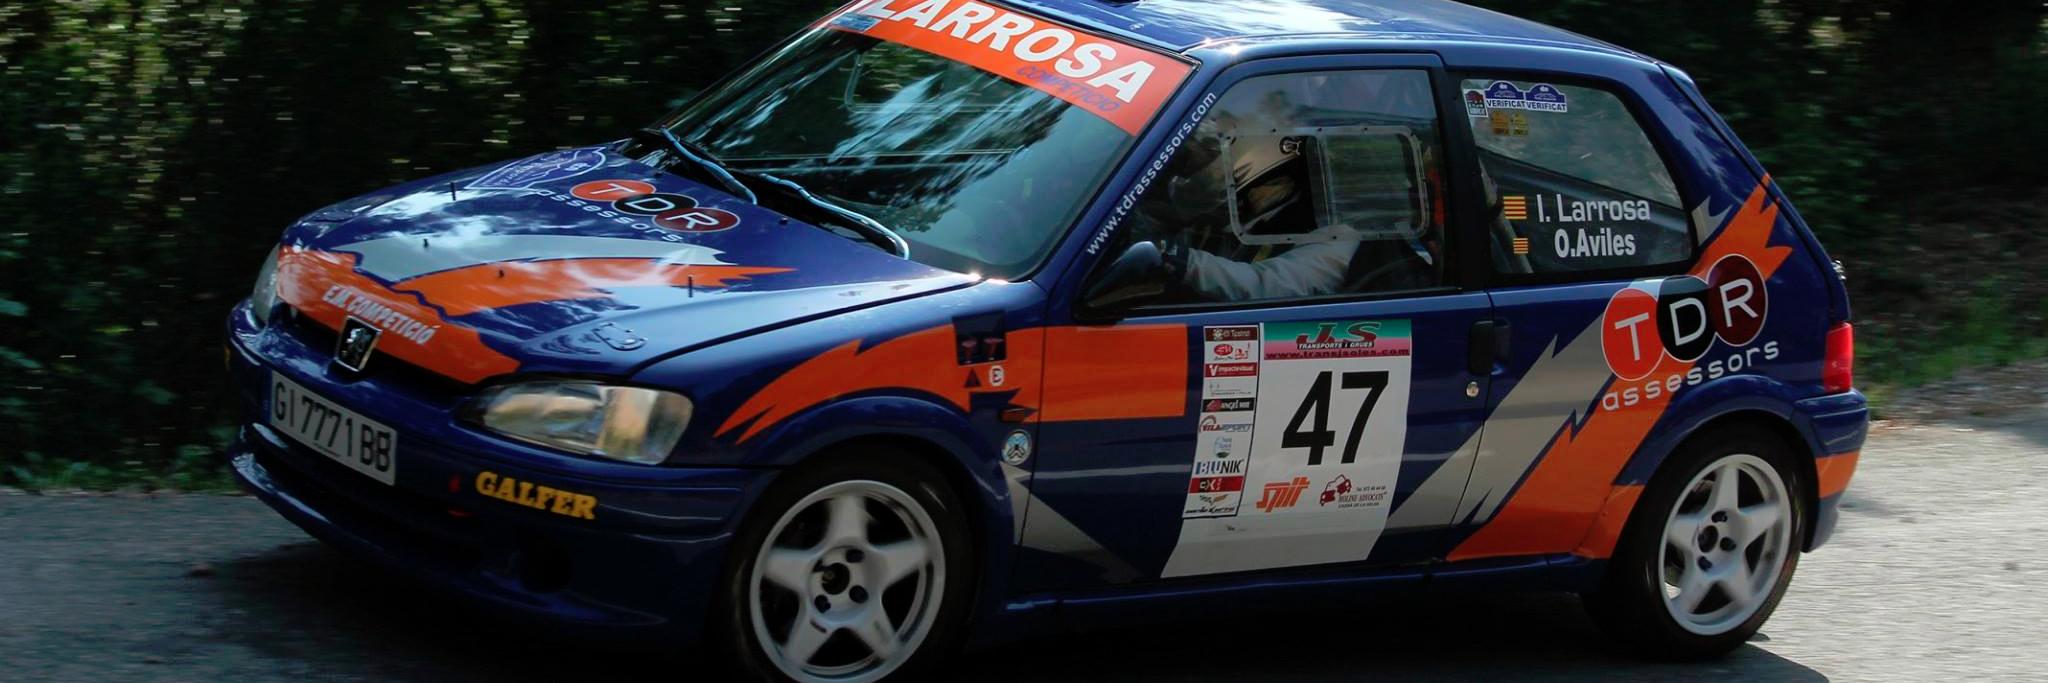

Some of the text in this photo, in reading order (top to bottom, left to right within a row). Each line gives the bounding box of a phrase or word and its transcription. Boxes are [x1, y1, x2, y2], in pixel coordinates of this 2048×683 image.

[1487, 99, 1525, 108] VERIFICAT
[1527, 101, 1566, 111] VERIFICAT
[1088, 92, 1216, 255] www.tdrassessors.com
[534, 189, 682, 243] assessors
[589, 183, 720, 229] TDR
[1537, 193, 1650, 223] I. Larrosa
[1554, 228, 1636, 258] O.Aviles
[1615, 277, 1758, 361] TDR
[1298, 342, 1342, 350] TRANSPORTS
[1602, 340, 1779, 411] assessors
[275, 381, 391, 472] GI 7771 BB
[1281, 370, 1389, 465] 47
[476, 471, 597, 519] GALFER
